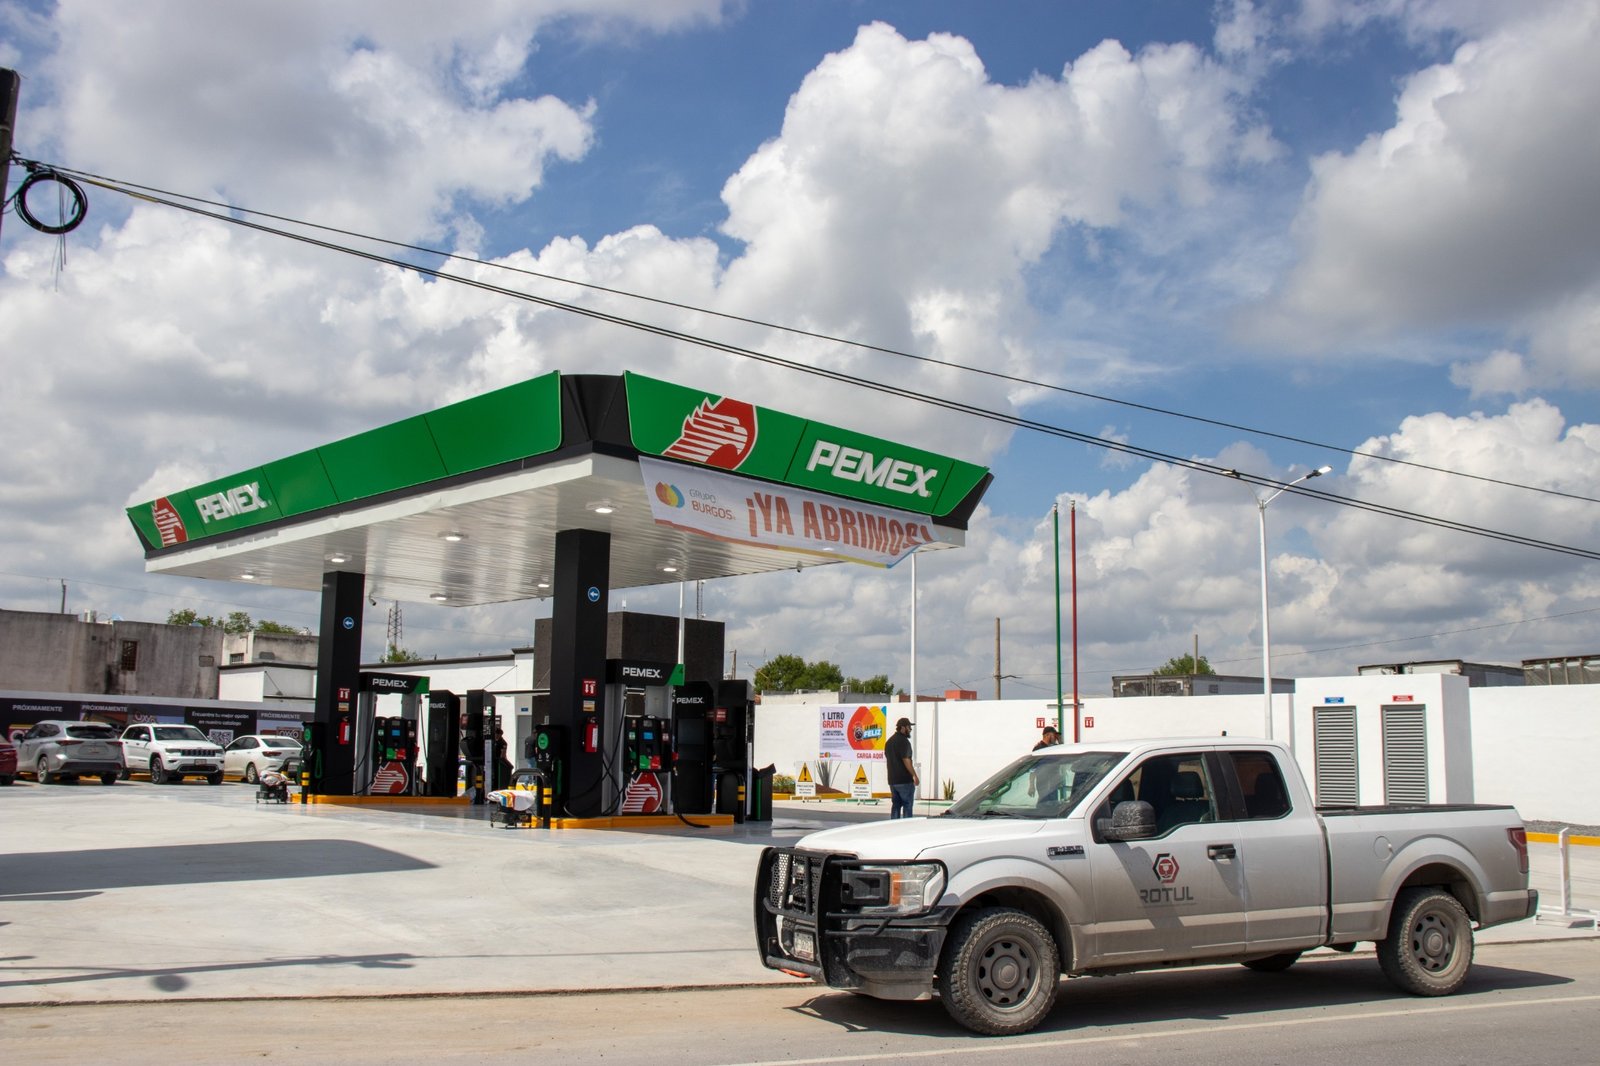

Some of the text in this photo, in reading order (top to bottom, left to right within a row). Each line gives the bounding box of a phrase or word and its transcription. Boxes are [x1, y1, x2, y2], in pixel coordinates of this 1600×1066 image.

[805, 439, 938, 498] PEMEX
[689, 488, 716, 504] GRUPO
[195, 481, 268, 524] PEMEX
[691, 500, 734, 520] BURGOS
[745, 491, 794, 537] ¡YA
[622, 666, 661, 679] PEMEX
[372, 678, 408, 688] PEMEX
[12, 704, 63, 713] PRÓXIMAMENTE
[81, 704, 128, 713] PRÓXIMAMENTE
[260, 712, 300, 720] PRÓXIMAMENTE
[822, 711, 845, 720] 1 LITRO
[822, 720, 844, 729] GRATIS
[863, 728, 883, 738] FELIZ
[1139, 886, 1194, 904] ROTUL
